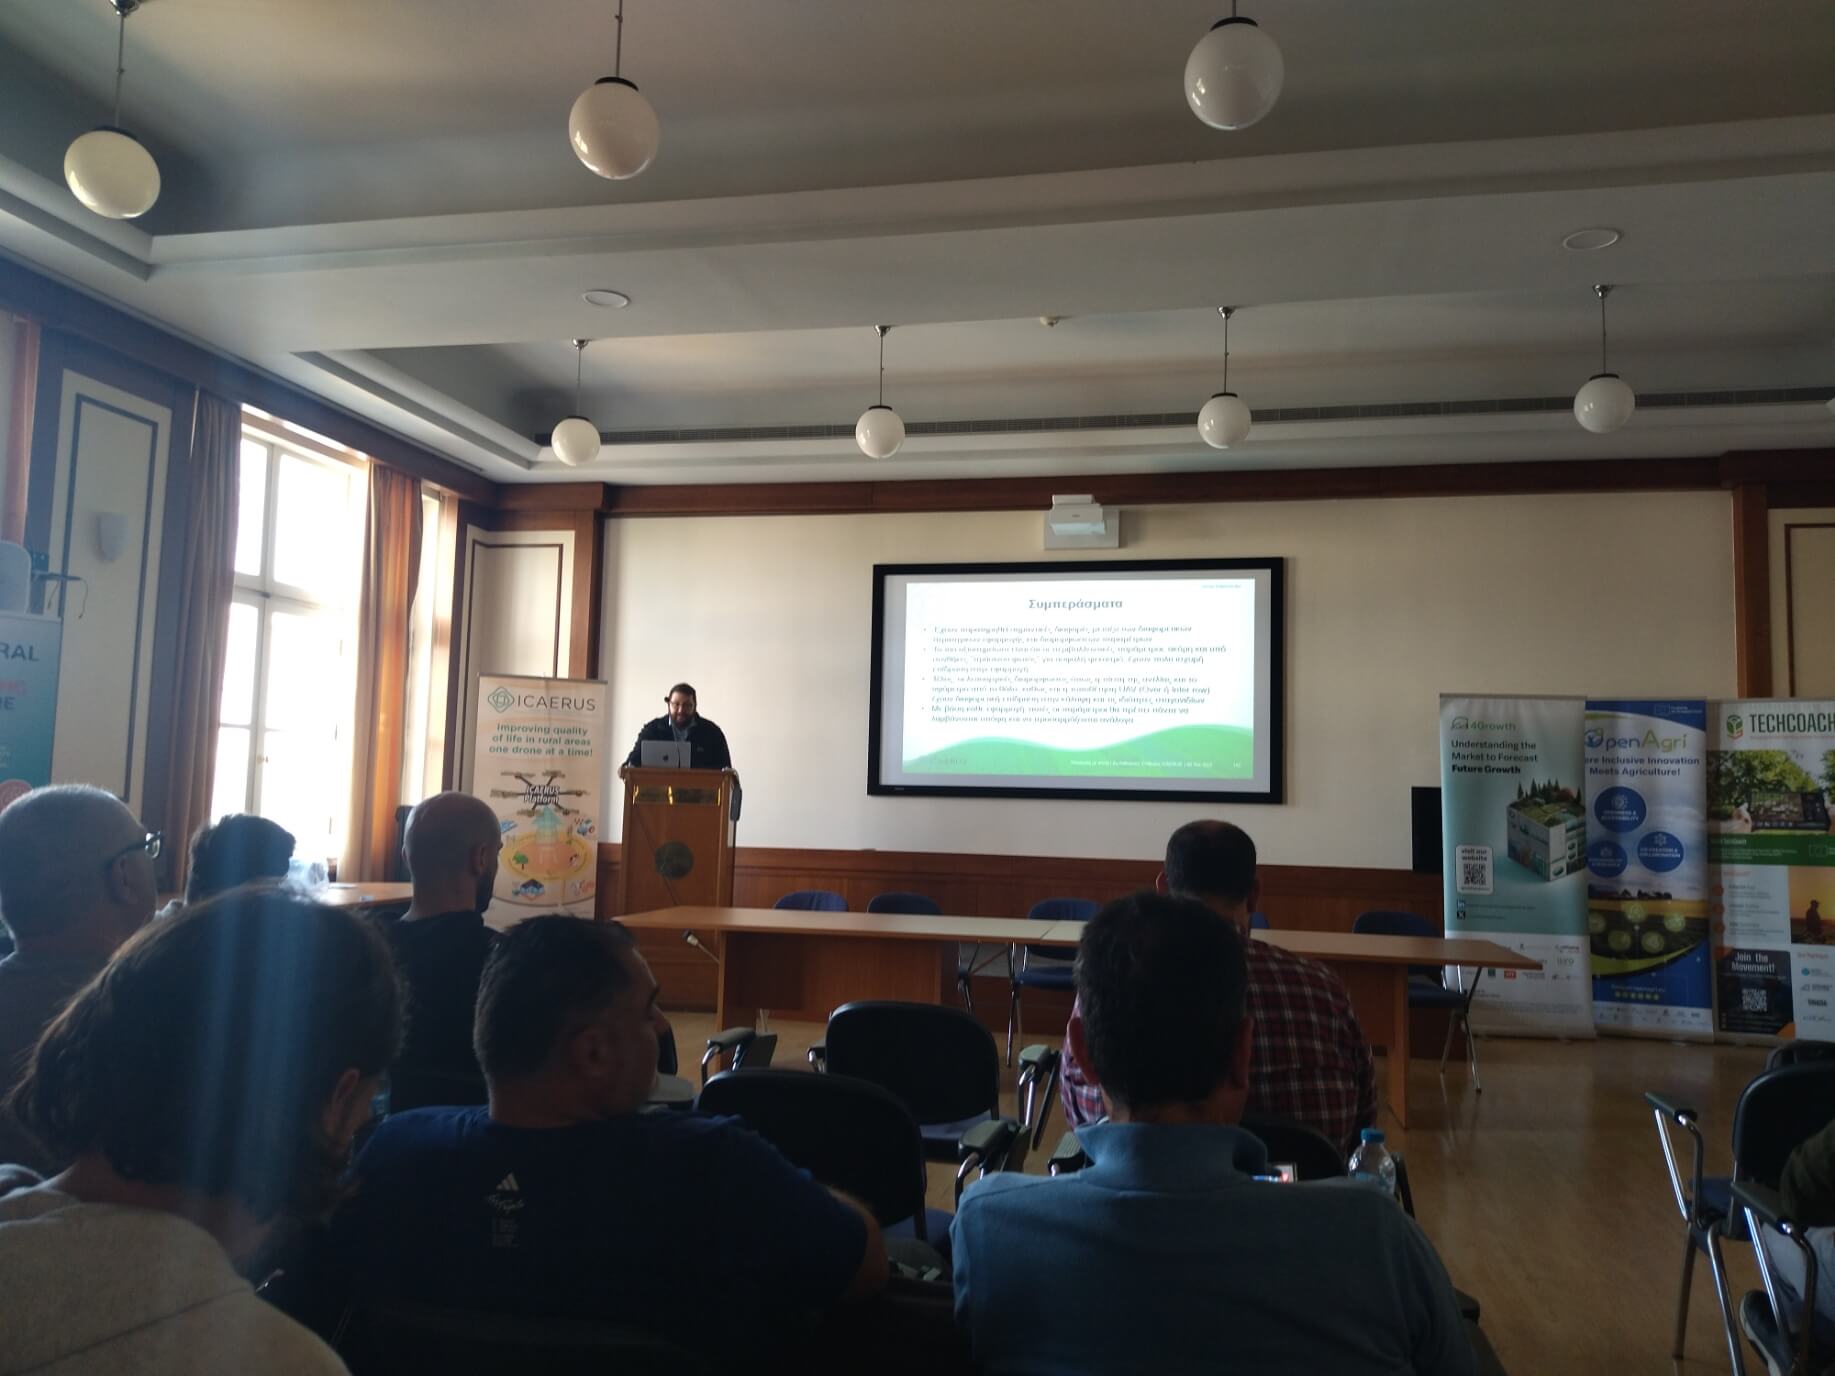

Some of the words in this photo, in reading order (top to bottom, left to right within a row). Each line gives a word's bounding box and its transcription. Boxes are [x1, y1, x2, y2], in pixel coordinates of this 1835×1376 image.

[1029, 598, 1123, 611] Συμπεράσματα
[517, 694, 597, 712] ICAERUS
[1749, 713, 1835, 733] TECHCOACH
[497, 723, 550, 735] Improving
[553, 726, 588, 737] quality
[492, 733, 503, 743] of
[506, 734, 522, 743] life
[526, 735, 535, 743] in
[538, 736, 562, 745] rural
[564, 738, 591, 746] areas
[1451, 740, 1519, 752] Understanding
[1521, 741, 1537, 750] the
[512, 745, 543, 755] drone
[545, 747, 555, 755] at
[567, 748, 593, 758] time!
[1451, 752, 1482, 761] Market
[1486, 752, 1496, 761] to
[1498, 753, 1538, 762] Forecast
[1602, 756, 1646, 765] Inclusive
[1647, 756, 1700, 766] Innovation
[1451, 764, 1483, 774] Future
[1484, 765, 1521, 774] Growth
[1589, 767, 1620, 776] Meets
[1622, 767, 1681, 777] Agriculture!
[1735, 951, 1752, 961] Join
[1755, 952, 1769, 962] the
[1731, 961, 1776, 974] Movement!
